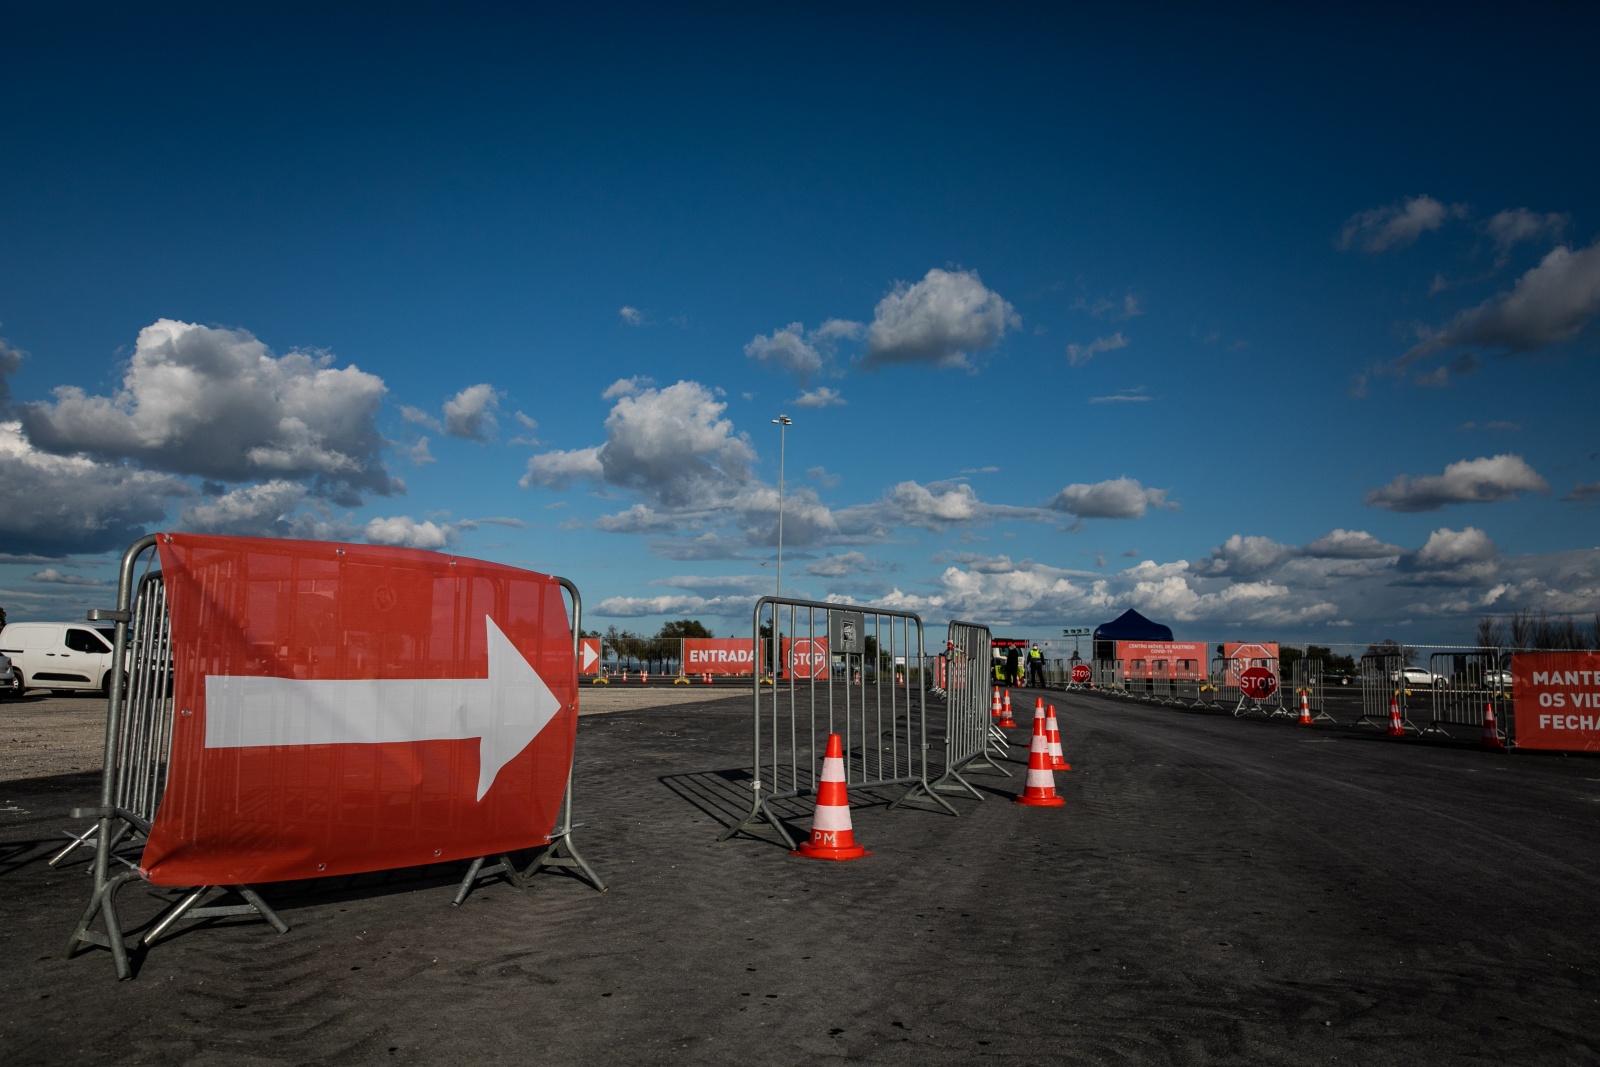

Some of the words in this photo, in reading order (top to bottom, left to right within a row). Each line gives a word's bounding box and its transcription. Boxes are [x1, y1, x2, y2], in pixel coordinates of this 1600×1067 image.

[689, 649, 755, 663] ENTRADA
[1071, 669, 1090, 678] STOP
[1241, 676, 1275, 689] STOP
[1539, 692, 1566, 708] OS
[813, 831, 837, 848] PM
